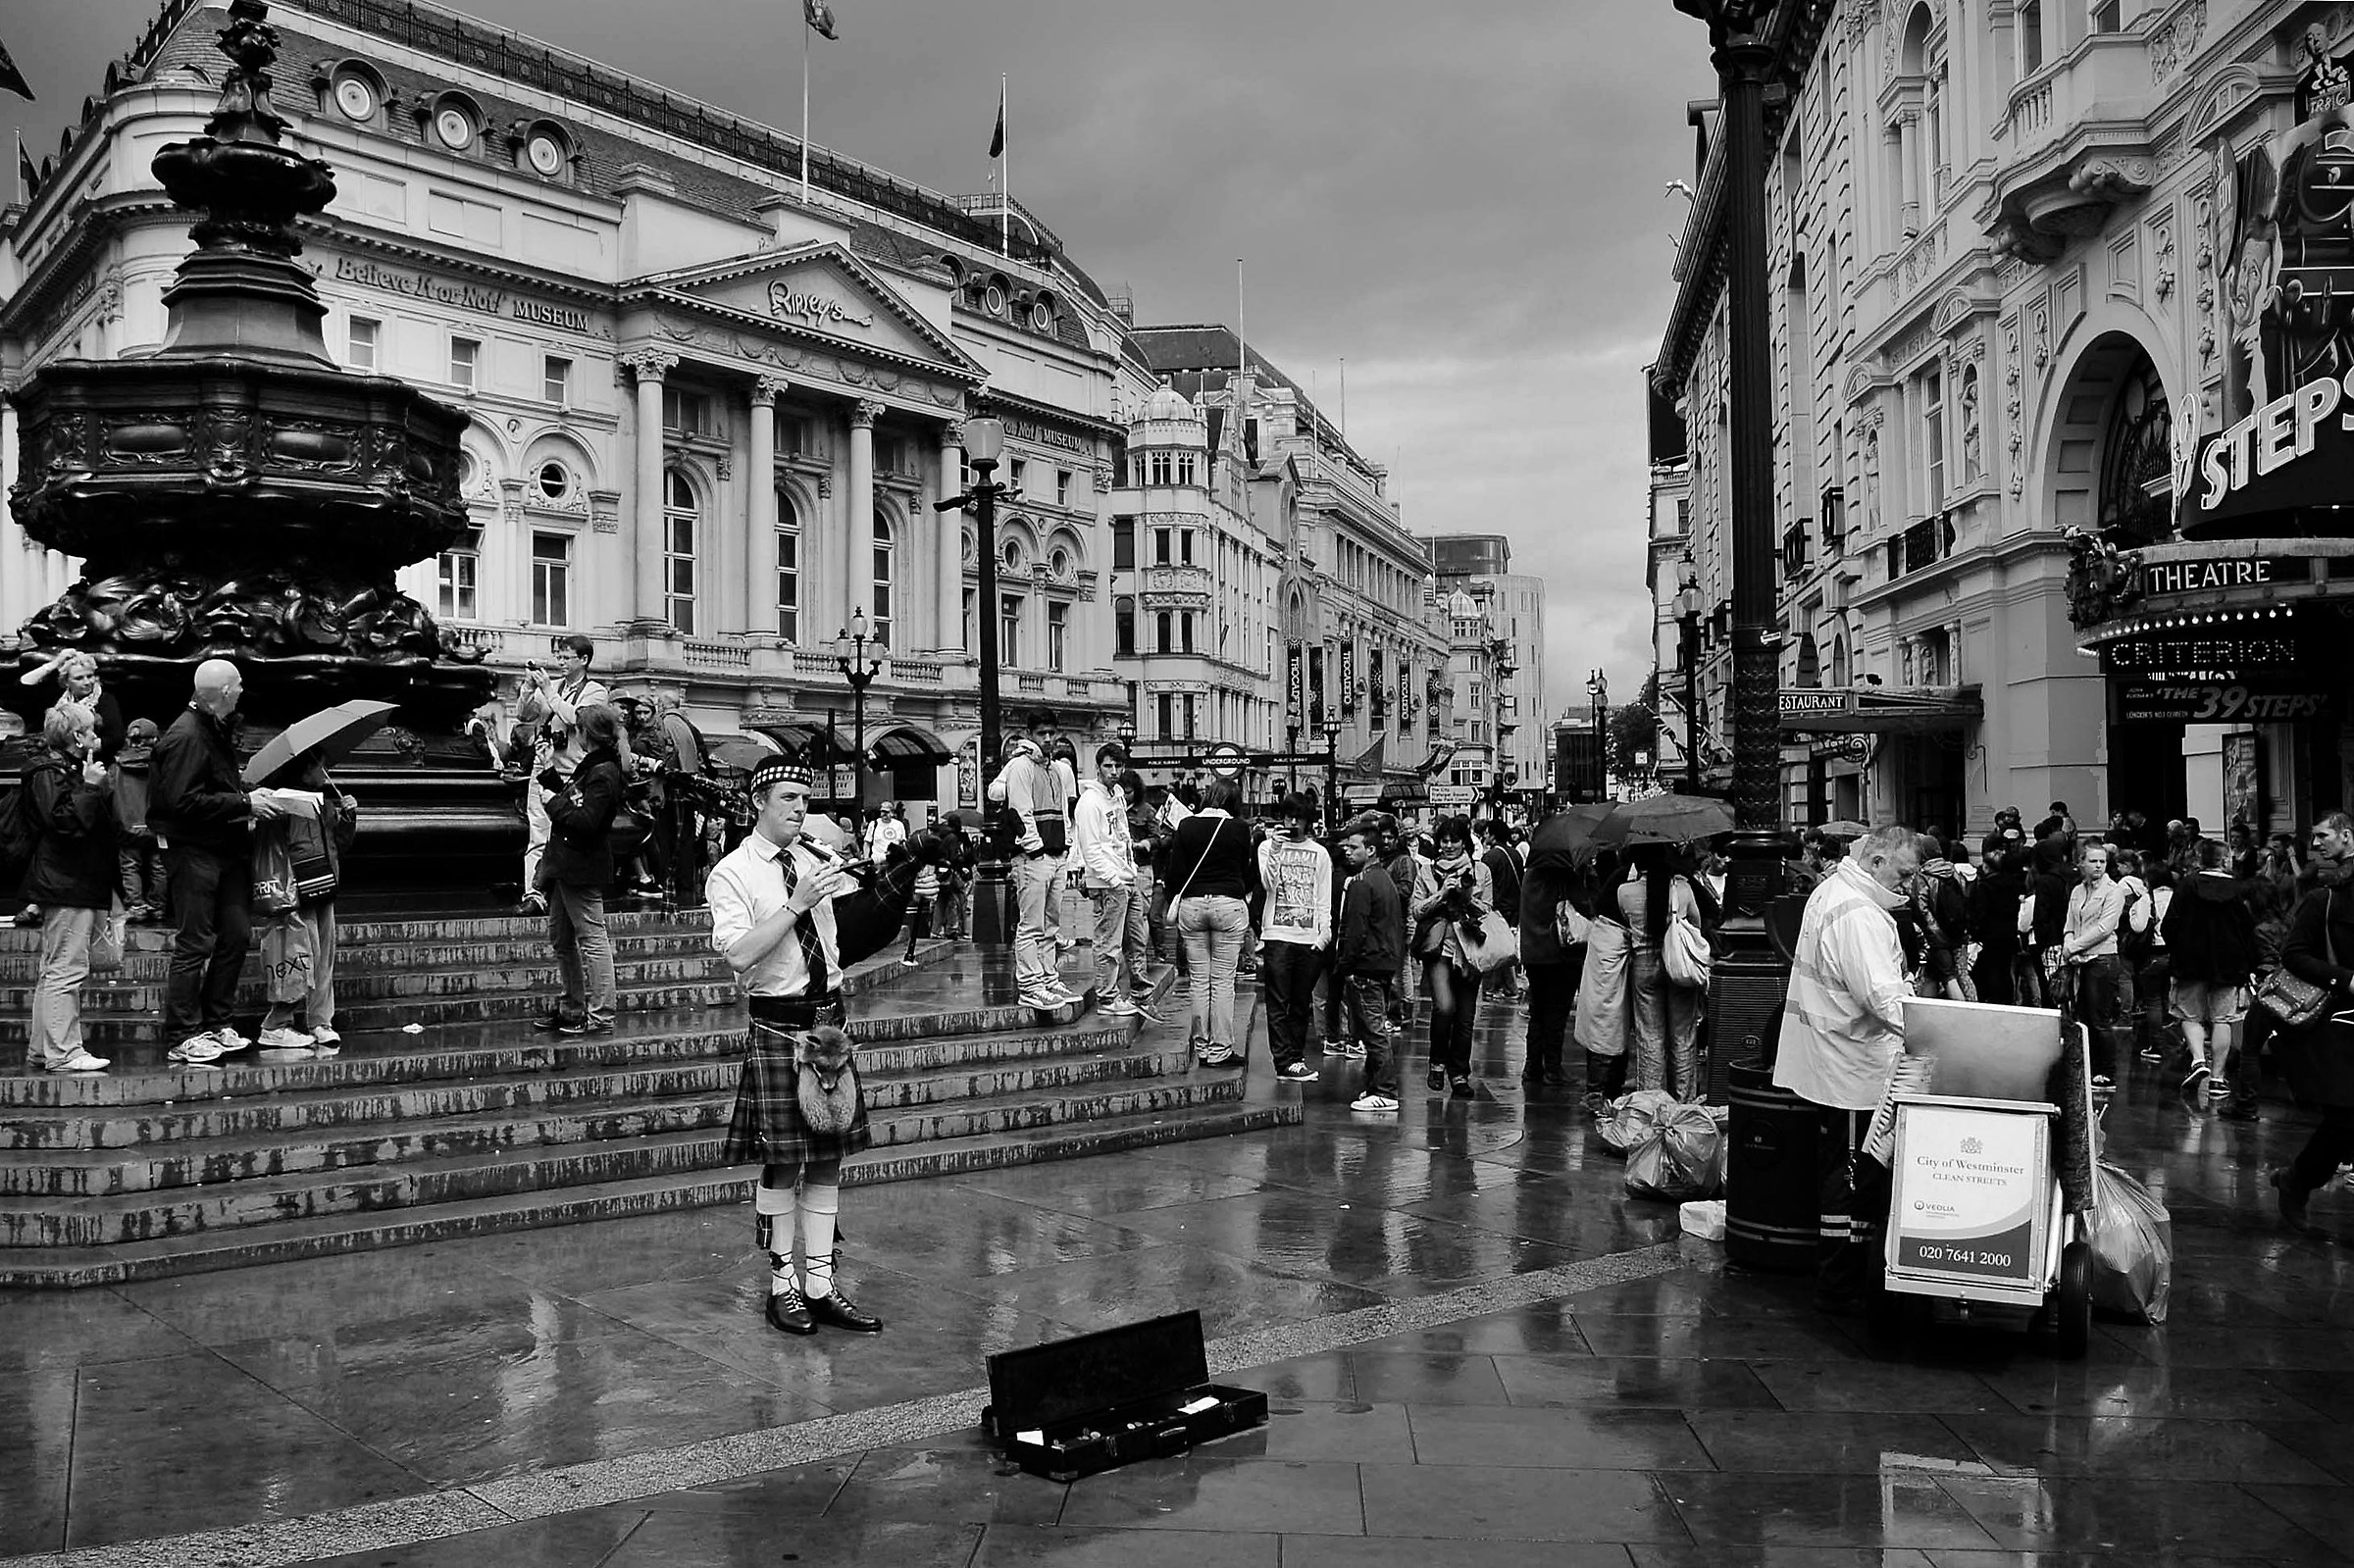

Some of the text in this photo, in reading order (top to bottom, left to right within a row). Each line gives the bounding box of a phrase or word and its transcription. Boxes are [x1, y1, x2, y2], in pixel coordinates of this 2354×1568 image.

[336, 257, 409, 292] Believe
[512, 298, 588, 331] MUSEUM
[1043, 429, 1082, 450] MUSEUM
[2201, 365, 2354, 510] STEP
[2149, 560, 2272, 591] THEATRE
[2111, 638, 2296, 666] CRITERION
[1779, 695, 1843, 710] ESTAURANT
[2193, 685, 2248, 719] 39
[1917, 1156, 2024, 1175] City of Westminster
[1932, 1172, 2007, 1187] CLEAN STREETS
[1925, 1203, 1955, 1212] VEOLIA
[1919, 1244, 2011, 1267] 020 7641 2000
